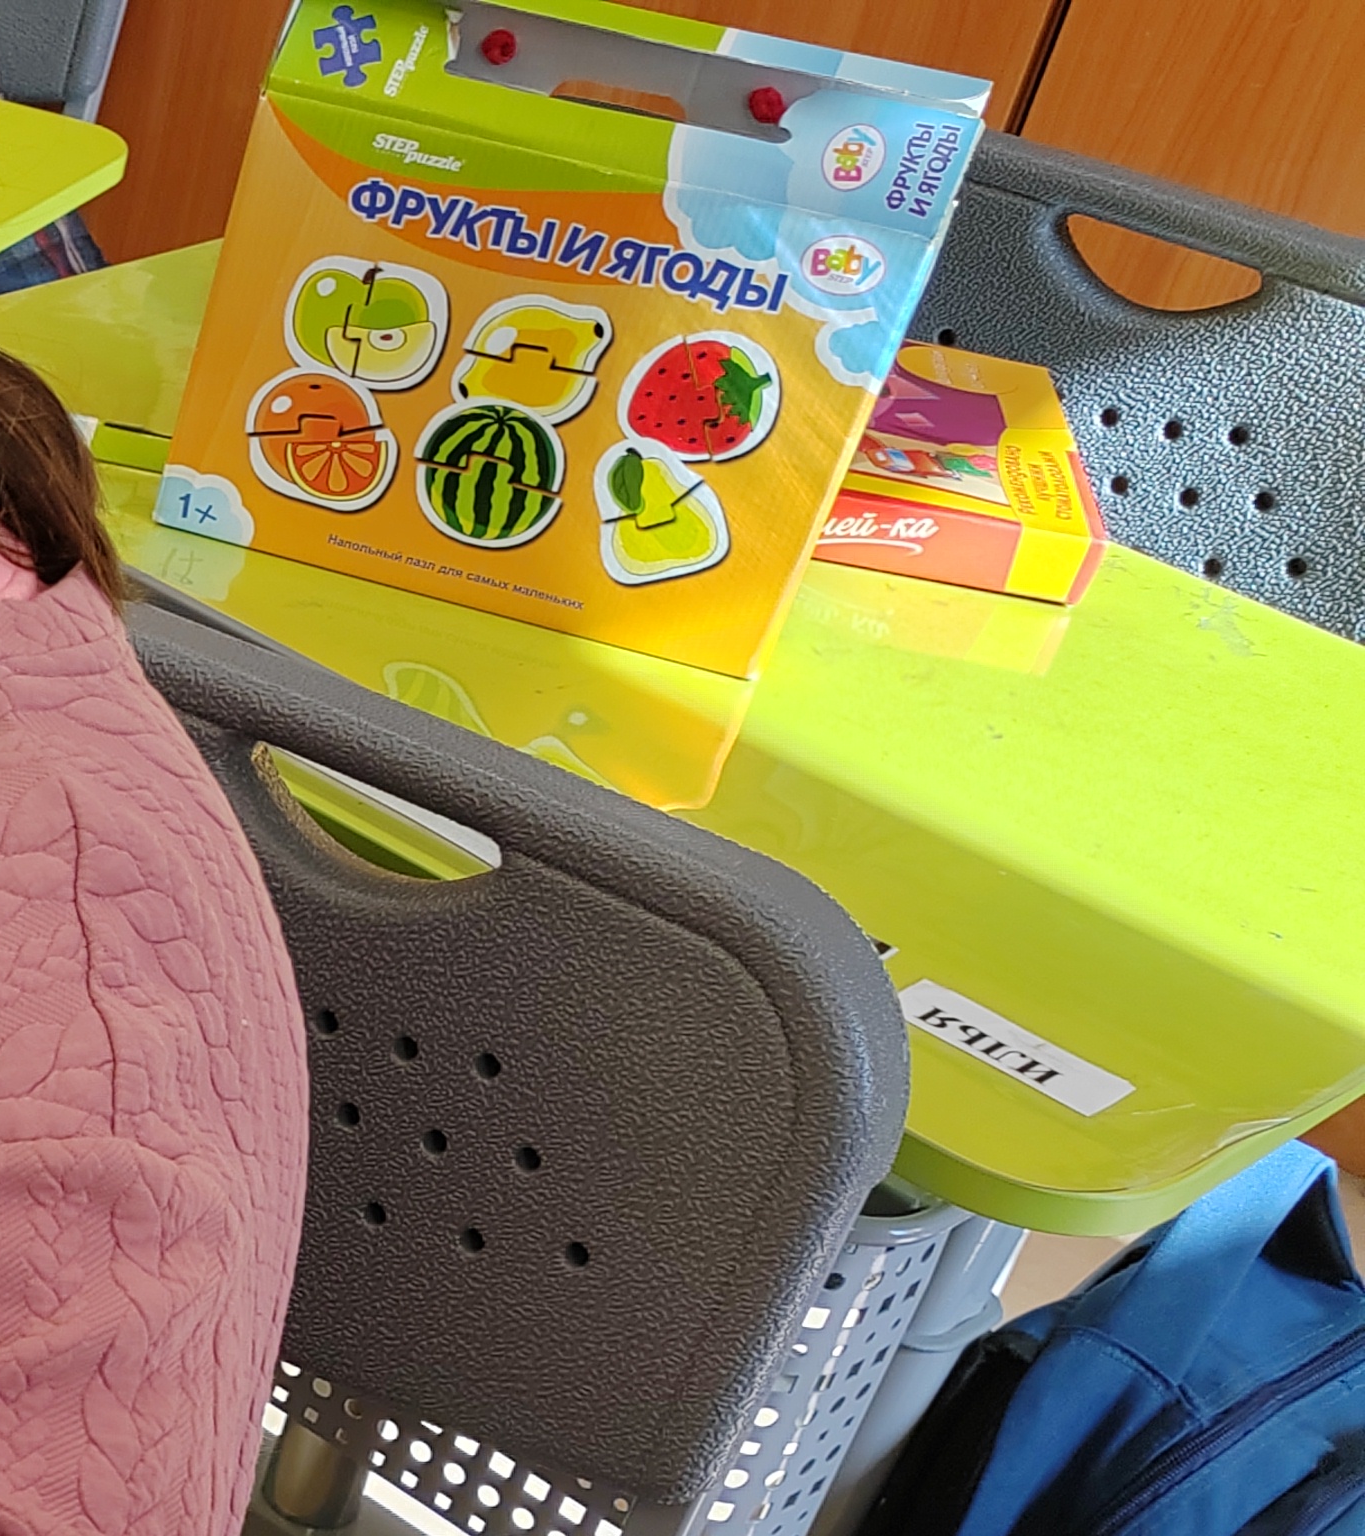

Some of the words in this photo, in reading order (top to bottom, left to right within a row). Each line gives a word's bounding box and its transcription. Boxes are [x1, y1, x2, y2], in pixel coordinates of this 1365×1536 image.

[384, 59, 404, 97] STEP
[404, 25, 429, 72] puzzle
[372, 133, 419, 153] STEP
[404, 148, 464, 172] puzzle
[833, 128, 876, 181] Baby
[885, 123, 936, 209] ФРУКТЫ
[908, 198, 932, 217] И
[922, 125, 961, 196] ЯГОДЫ
[349, 179, 557, 260] ФРУКТЫ
[559, 226, 603, 272] И
[611, 239, 789, 312] ЯГОДЫ
[810, 245, 881, 286] Baby
[179, 493, 217, 524] 1+
[327, 533, 403, 562] Напольный
[405, 556, 436, 572] пазл
[437, 564, 463, 579] для
[466, 572, 509, 592] самых
[512, 584, 584, 611] маленьких
[916, 1006, 1065, 1088] ИЛЬЯ
